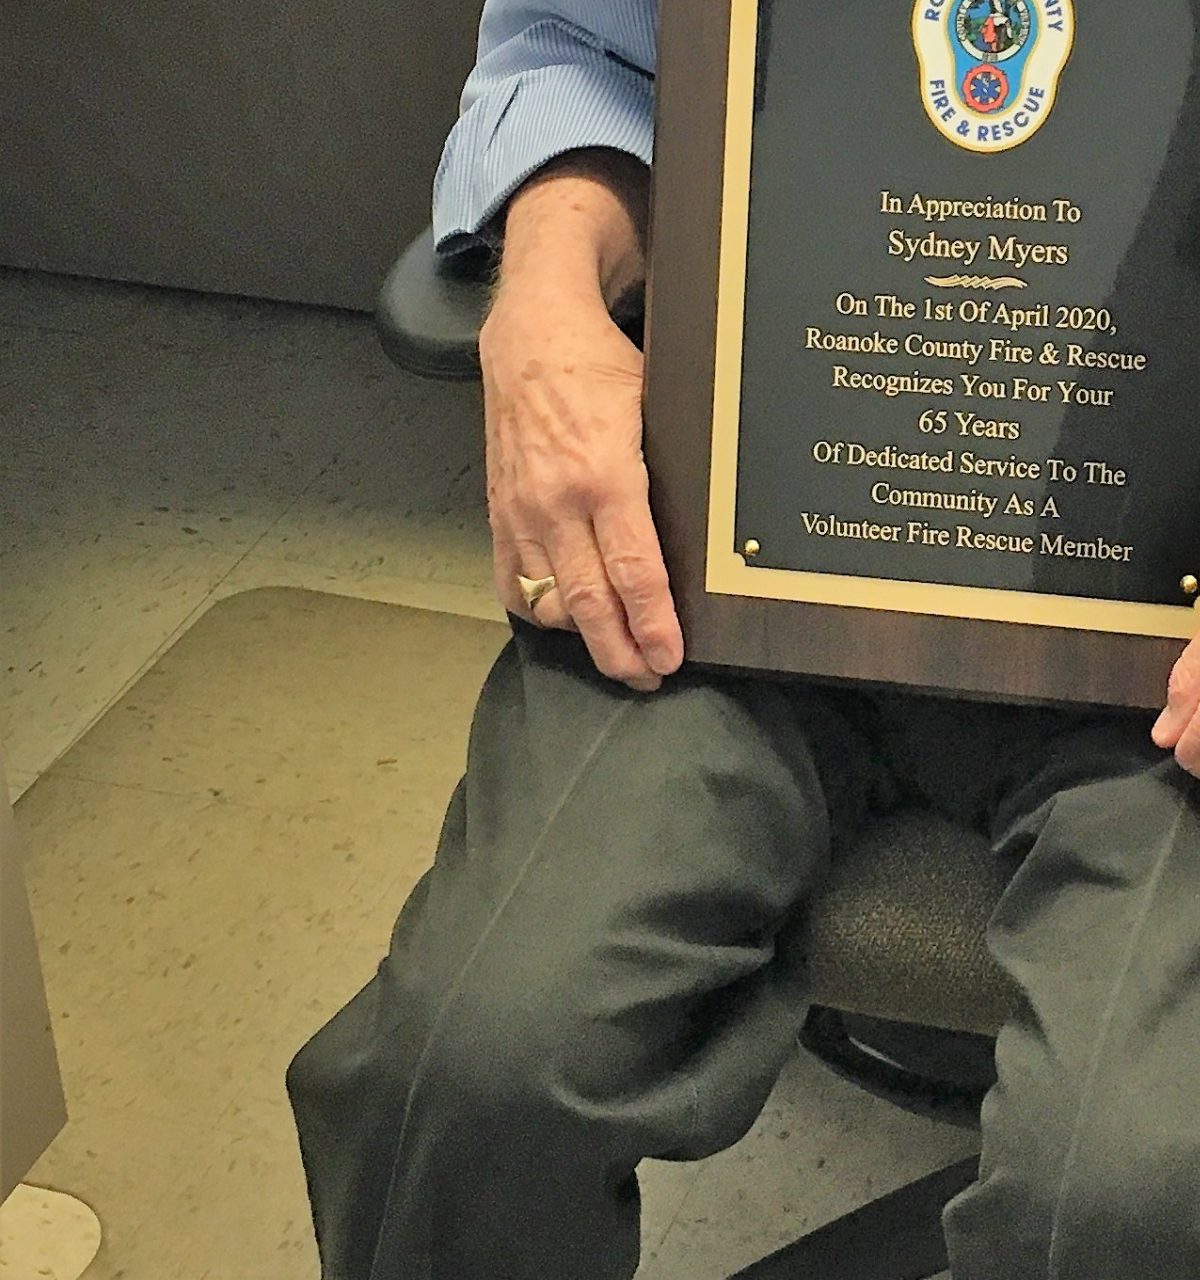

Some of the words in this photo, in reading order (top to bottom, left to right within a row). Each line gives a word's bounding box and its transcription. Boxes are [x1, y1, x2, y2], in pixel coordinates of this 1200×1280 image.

[929, 79, 957, 123] FIRE
[956, 119, 970, 138] &
[977, 86, 1045, 142] RESCUE
[880, 191, 903, 214] In
[908, 194, 1047, 221] Appreciation
[1053, 199, 1081, 224] To
[888, 230, 981, 265] Sydney
[988, 235, 1069, 268] Myers
[836, 292, 868, 316] On
[874, 294, 916, 319] The
[922, 298, 953, 321] 1st
[959, 300, 992, 323] Of
[992, 304, 1050, 331] April
[1055, 307, 1118, 336] 2020,
[805, 327, 899, 354] Roanoke
[904, 334, 984, 365] County
[989, 339, 1034, 364] Fire
[1038, 342, 1061, 366] &
[1066, 344, 1147, 371] Rescue
[832, 366, 954, 397] Recognizes
[960, 375, 1006, 399] You
[1012, 378, 1052, 402] For
[1057, 381, 1114, 407] Your
[918, 409, 948, 434] 65
[955, 411, 1021, 440] Years
[813, 441, 845, 464] Of
[847, 444, 954, 473] Dedicated
[960, 452, 1041, 480] Service
[1047, 459, 1078, 483] To
[1084, 462, 1127, 486] The
[871, 483, 999, 518] Community
[1004, 493, 1034, 517] As
[1040, 496, 1061, 519] A
[801, 512, 903, 542] Volunteer
[906, 523, 950, 547] Fire
[956, 527, 1034, 554] Rescue
[1040, 534, 1134, 562] Member
